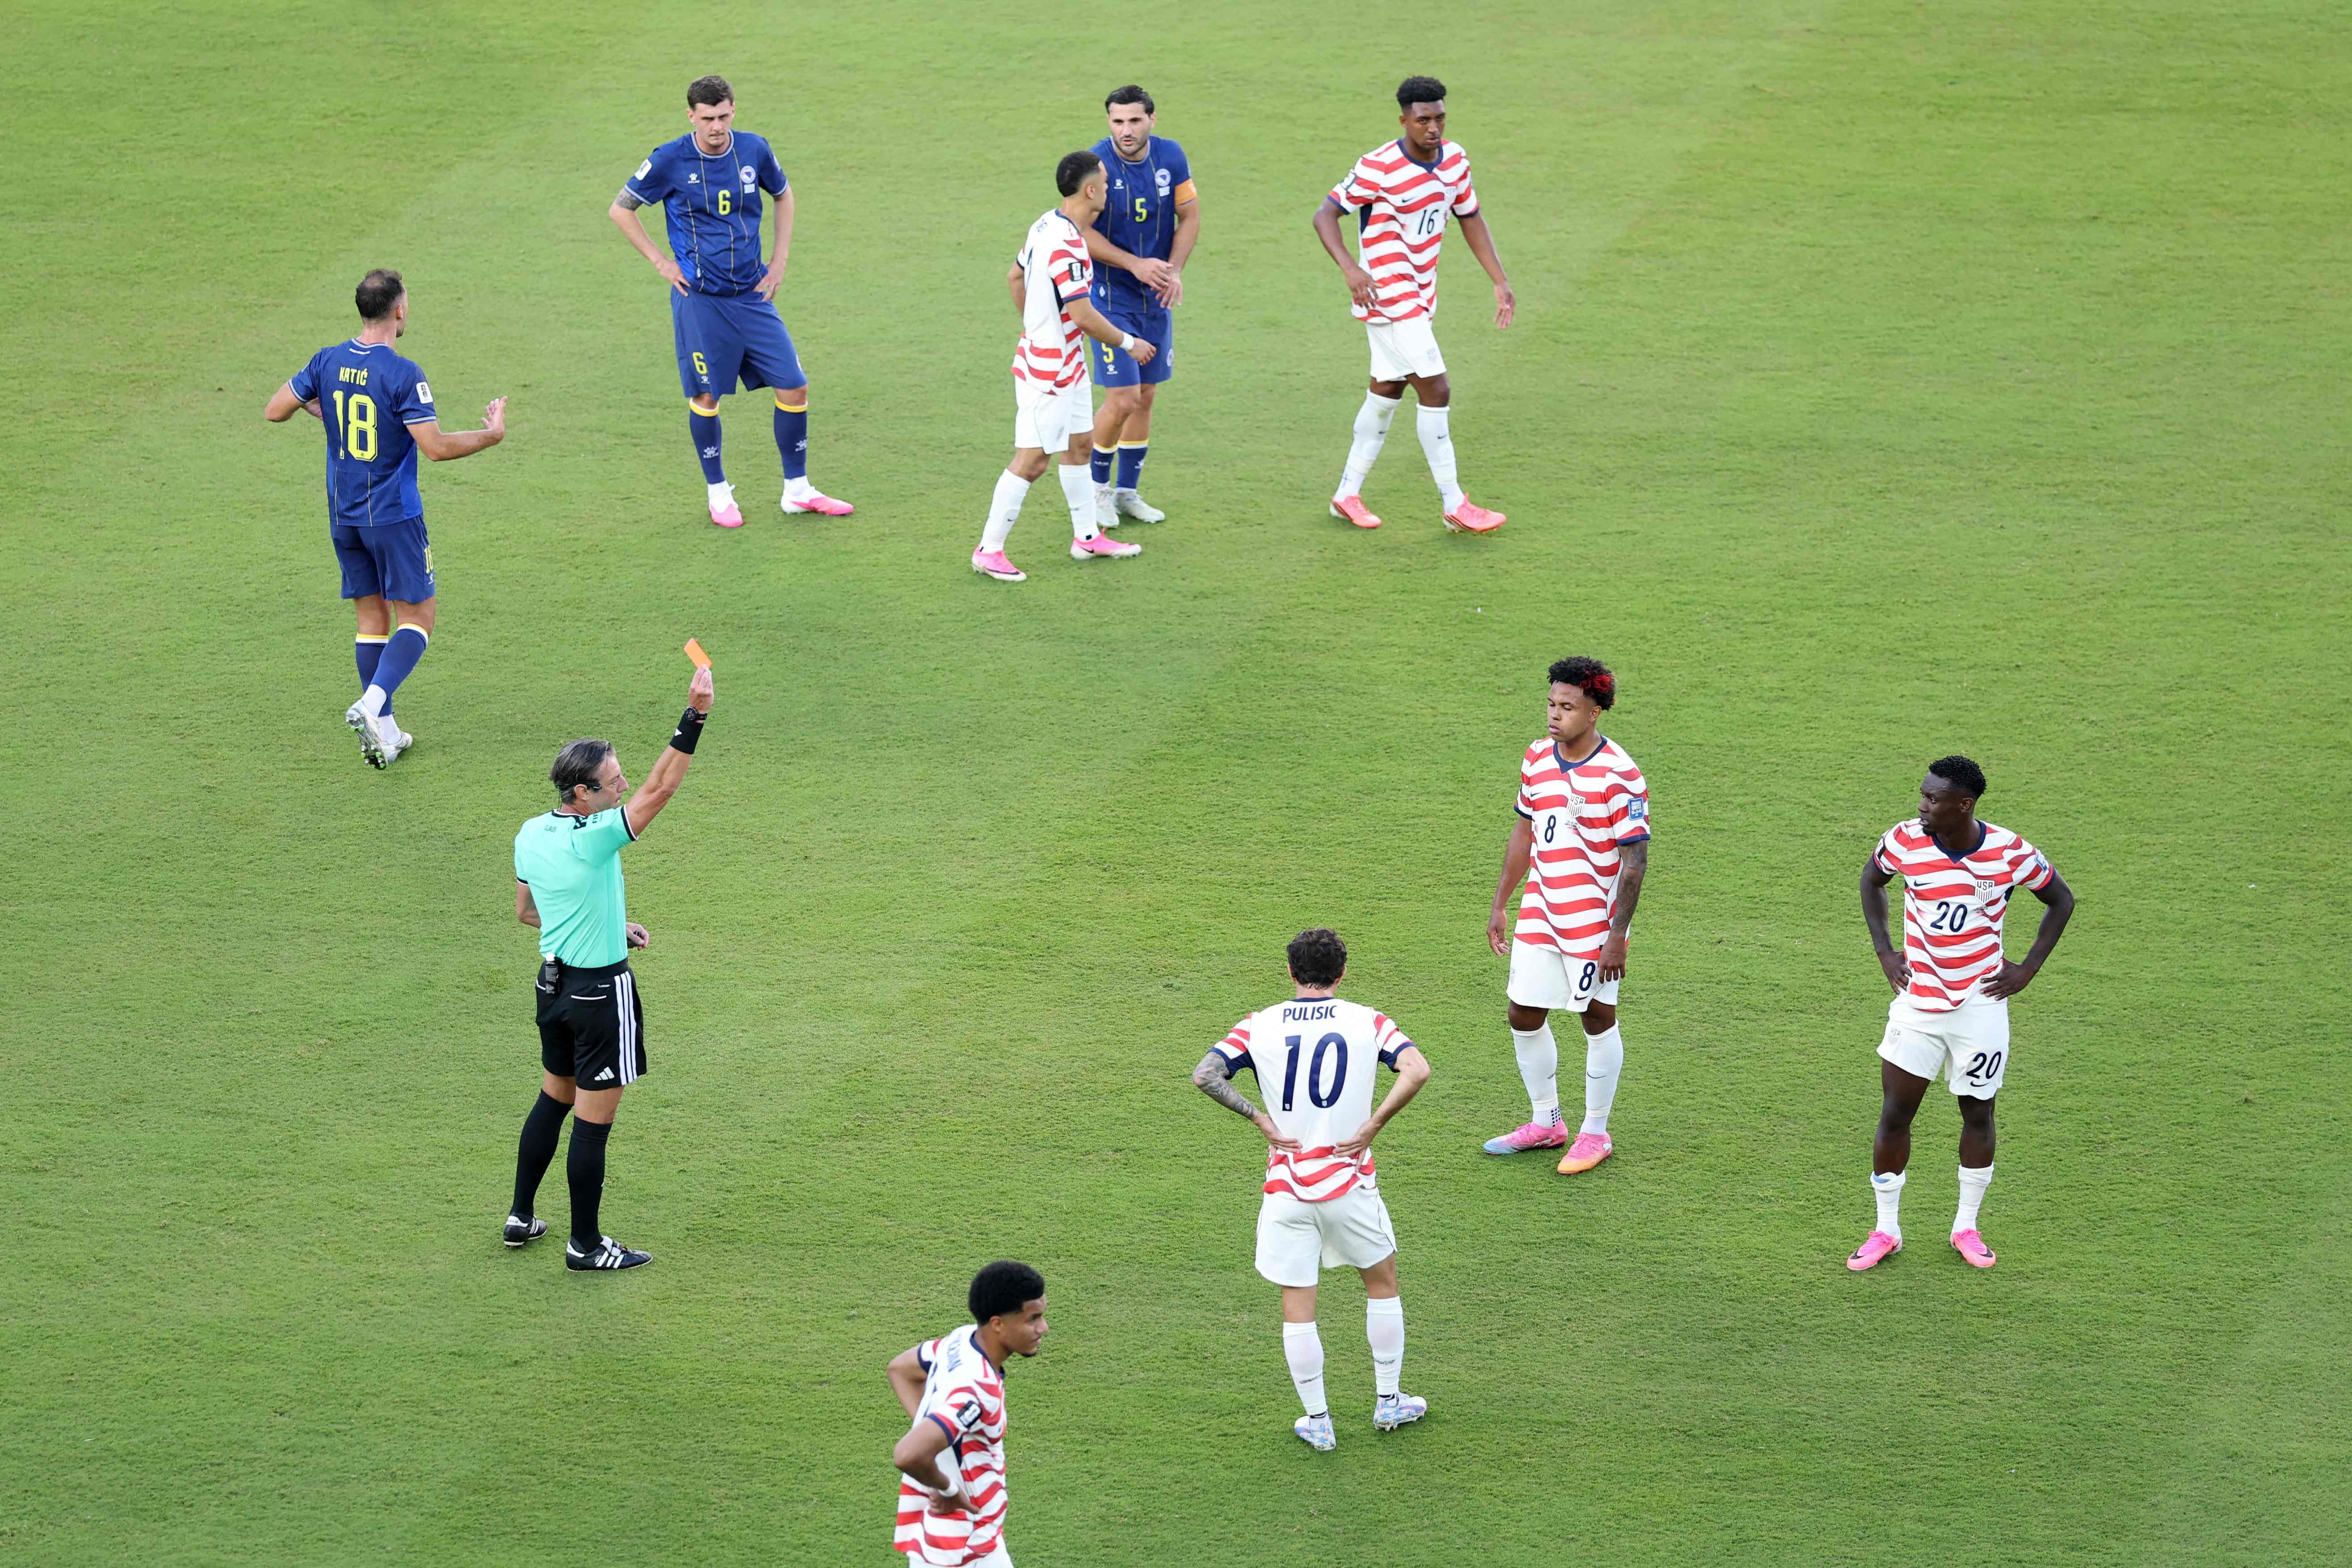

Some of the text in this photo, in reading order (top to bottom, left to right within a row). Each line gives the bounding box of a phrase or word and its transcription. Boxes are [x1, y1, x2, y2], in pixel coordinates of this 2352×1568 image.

[718, 190, 731, 215] 6
[1134, 198, 1147, 222] 5
[1417, 209, 1439, 235] 16
[692, 351, 708, 375] 6
[339, 367, 368, 386] KATIĆ
[333, 390, 378, 462] 18
[1570, 795, 1584, 805] USA
[1544, 815, 1556, 843] 8
[1977, 881, 1993, 890] USA
[1930, 901, 1968, 932] 20
[1579, 962, 1596, 991] 8
[1282, 1005, 1337, 1023] PULISIC
[1891, 1027, 1901, 1036] USA
[1282, 1032, 1348, 1112] 10
[1966, 1051, 2002, 1079] 20
